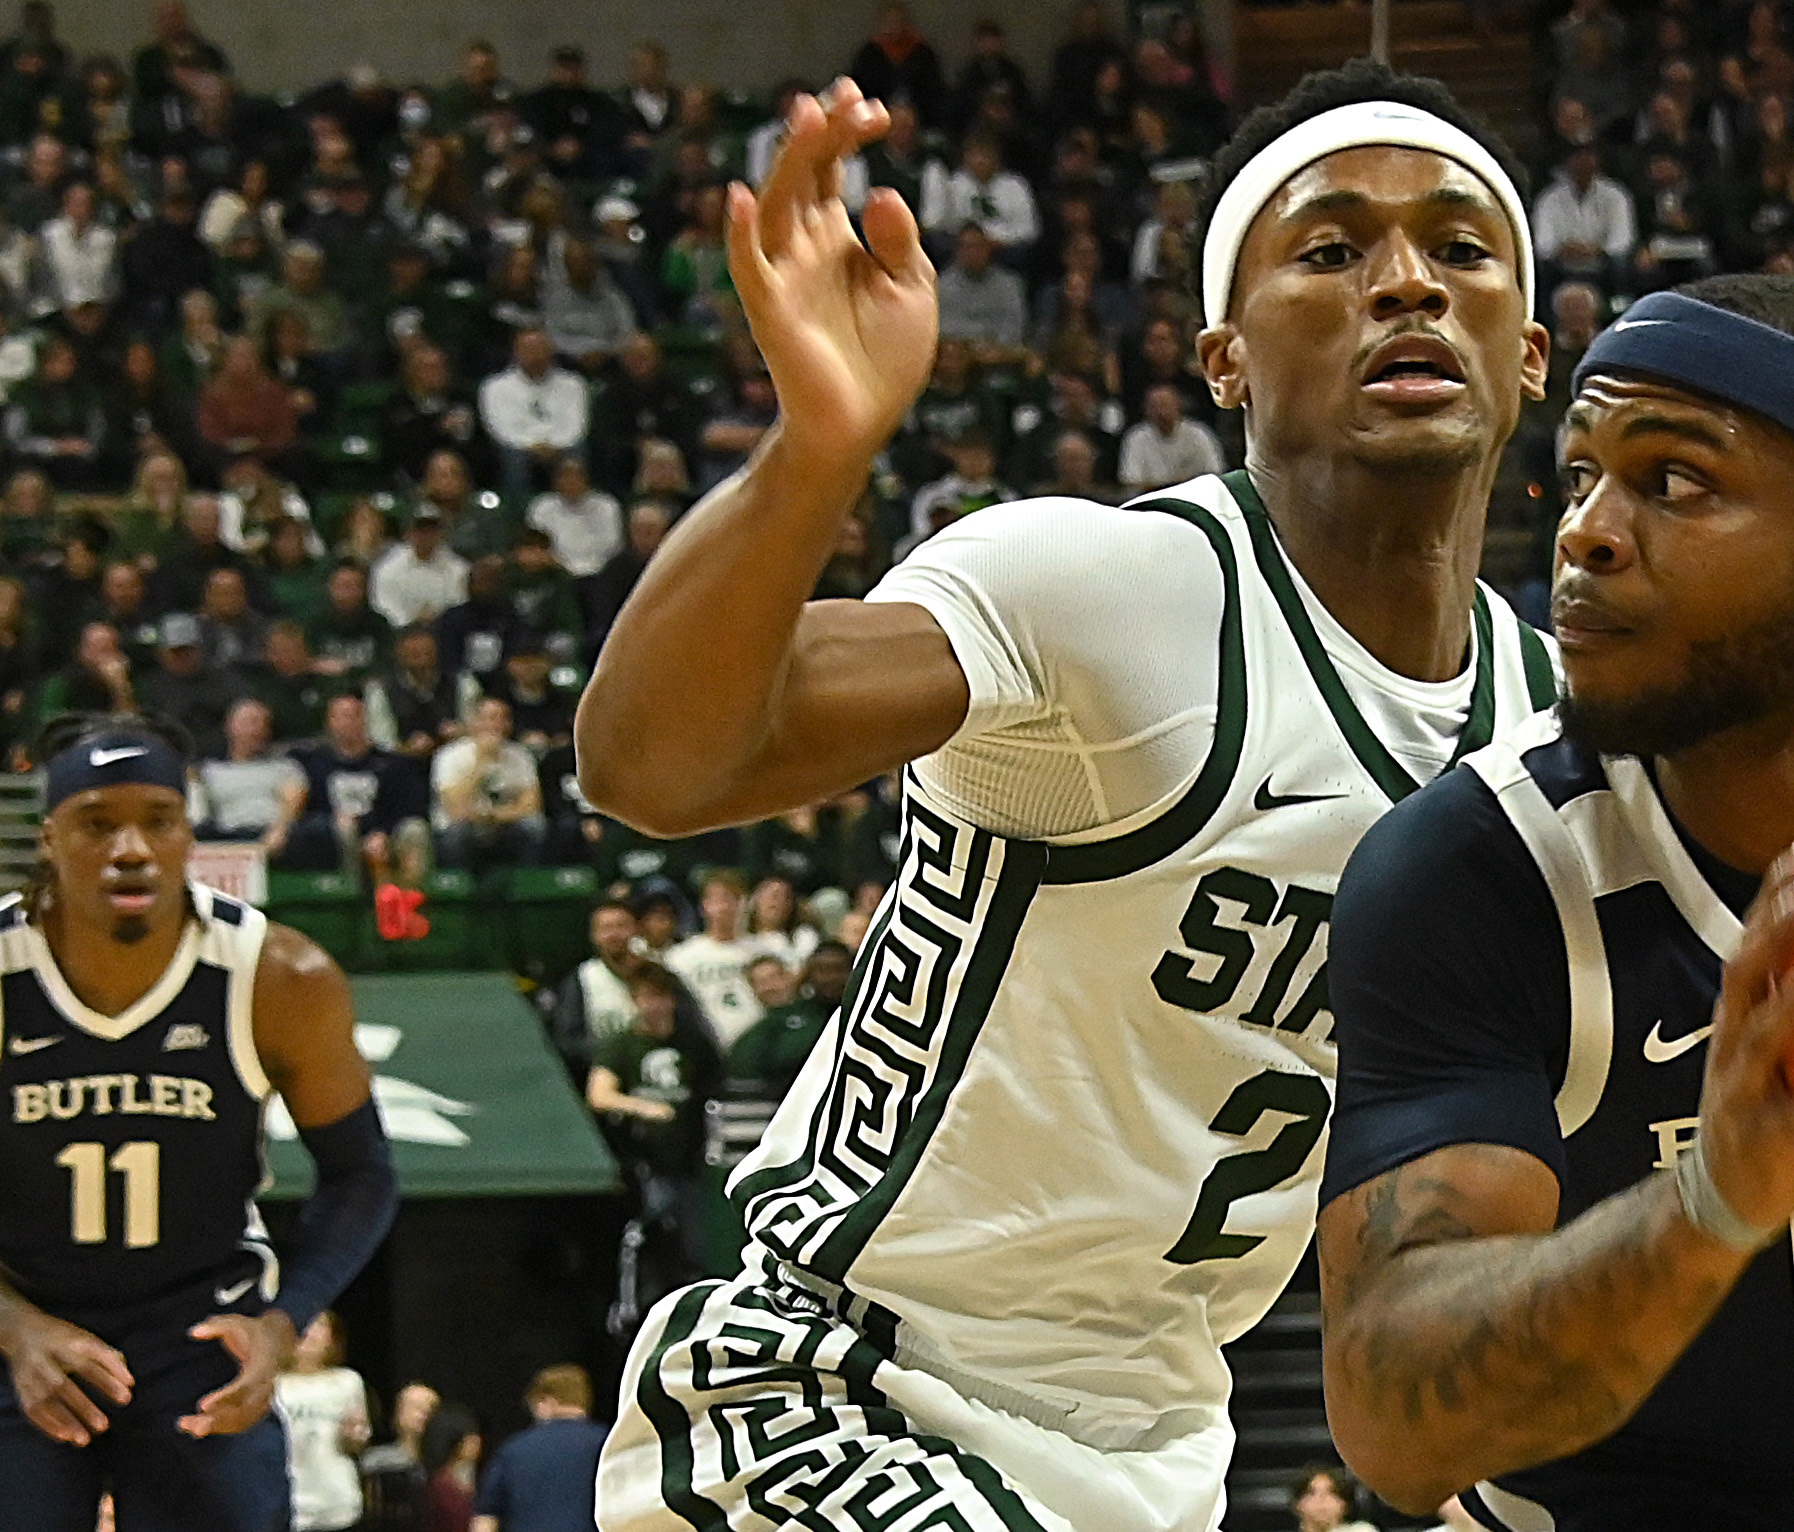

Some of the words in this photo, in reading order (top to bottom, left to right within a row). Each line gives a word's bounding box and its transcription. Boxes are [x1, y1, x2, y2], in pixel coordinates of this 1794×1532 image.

[12, 1072, 218, 1124] BUTLER
[54, 1140, 160, 1250] 11
[1162, 1068, 1332, 1265] 2
